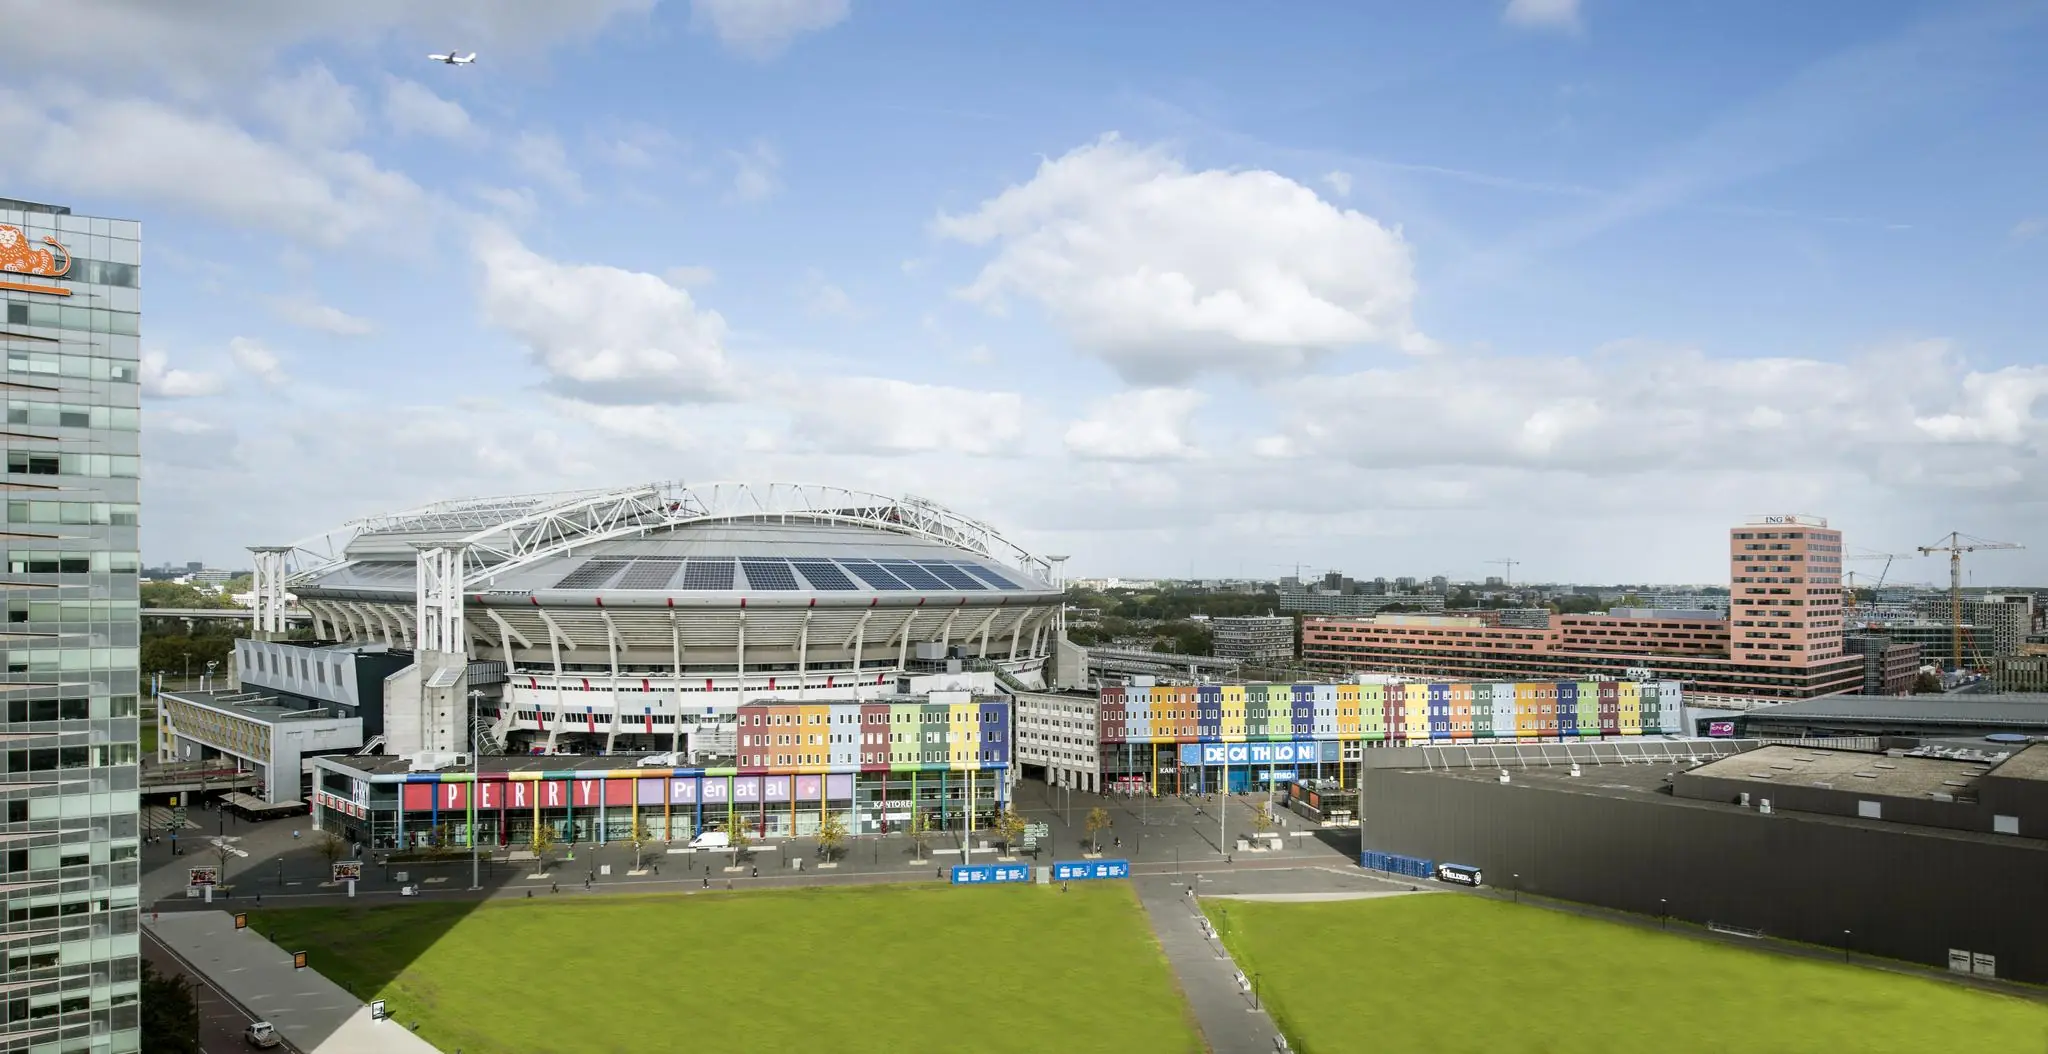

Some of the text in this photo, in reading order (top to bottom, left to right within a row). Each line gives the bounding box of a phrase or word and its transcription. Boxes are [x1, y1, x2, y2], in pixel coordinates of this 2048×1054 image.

[1765, 516, 1783, 524] ING
[1205, 746, 1310, 762] DECATHLON
[448, 780, 592, 809] PERRY
[674, 780, 784, 799] Prénatal
